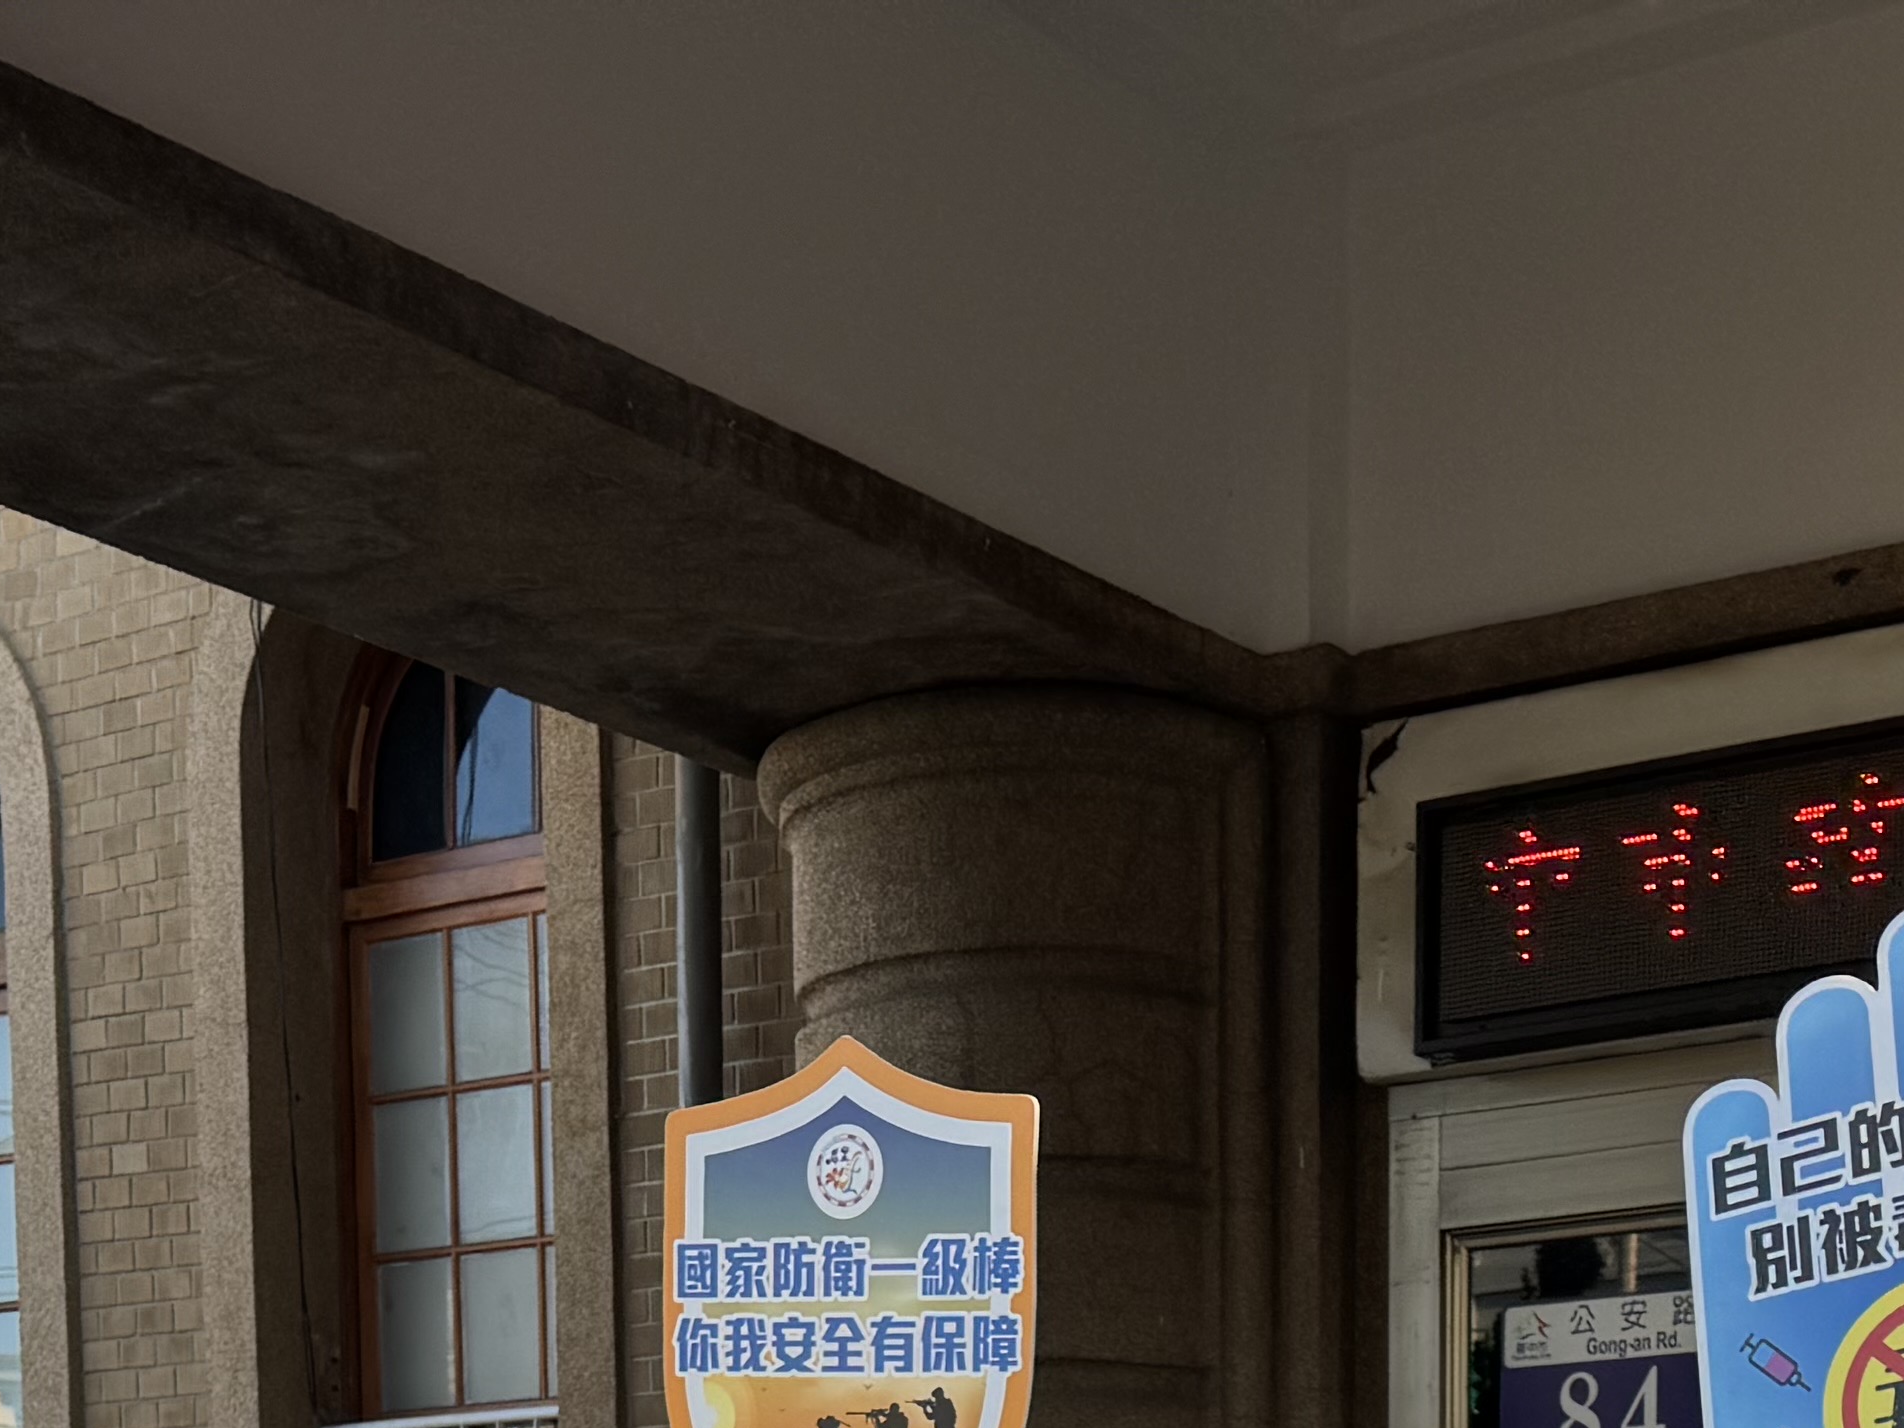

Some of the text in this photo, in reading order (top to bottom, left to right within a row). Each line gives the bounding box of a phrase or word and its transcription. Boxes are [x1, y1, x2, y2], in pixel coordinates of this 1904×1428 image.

[677, 1239, 1021, 1299] 國家防衛一級棒
[1571, 1295, 1694, 1334] 公安路
[678, 1317, 1019, 1373] 你我安全有保障
[1587, 1331, 1681, 1357] Gong-an Rd.
